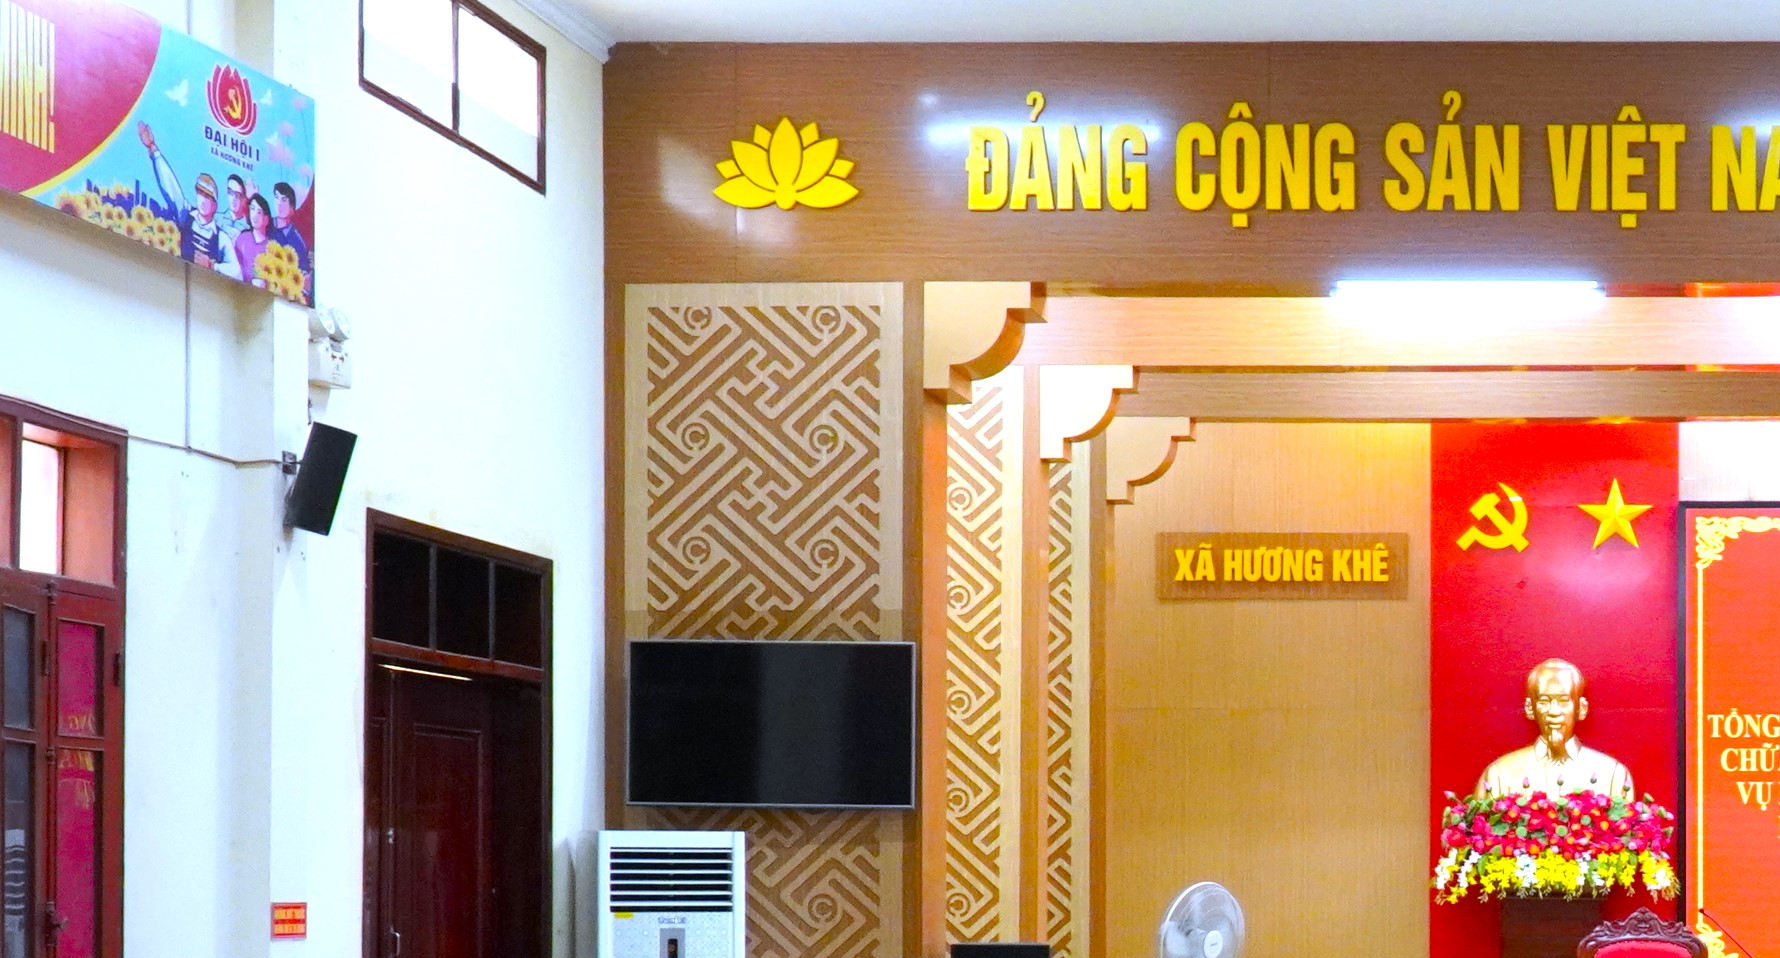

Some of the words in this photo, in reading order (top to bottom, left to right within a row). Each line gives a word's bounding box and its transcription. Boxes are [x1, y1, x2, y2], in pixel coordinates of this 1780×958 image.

[205, 126, 227, 147] ĐẠI
[231, 137, 252, 158] HỘI
[965, 91, 1147, 211] ĐẢNG
[1175, 102, 1356, 228] CỘNG
[1383, 90, 1520, 211] SẢN
[1547, 105, 1686, 228] VIỆT
[1174, 543, 1216, 582] XÃ
[1223, 546, 1324, 583] HƯƠNG
[1332, 543, 1389, 582] KHÊ
[1707, 708, 1780, 738] TỔNG
[1736, 781, 1773, 811] VỤ
